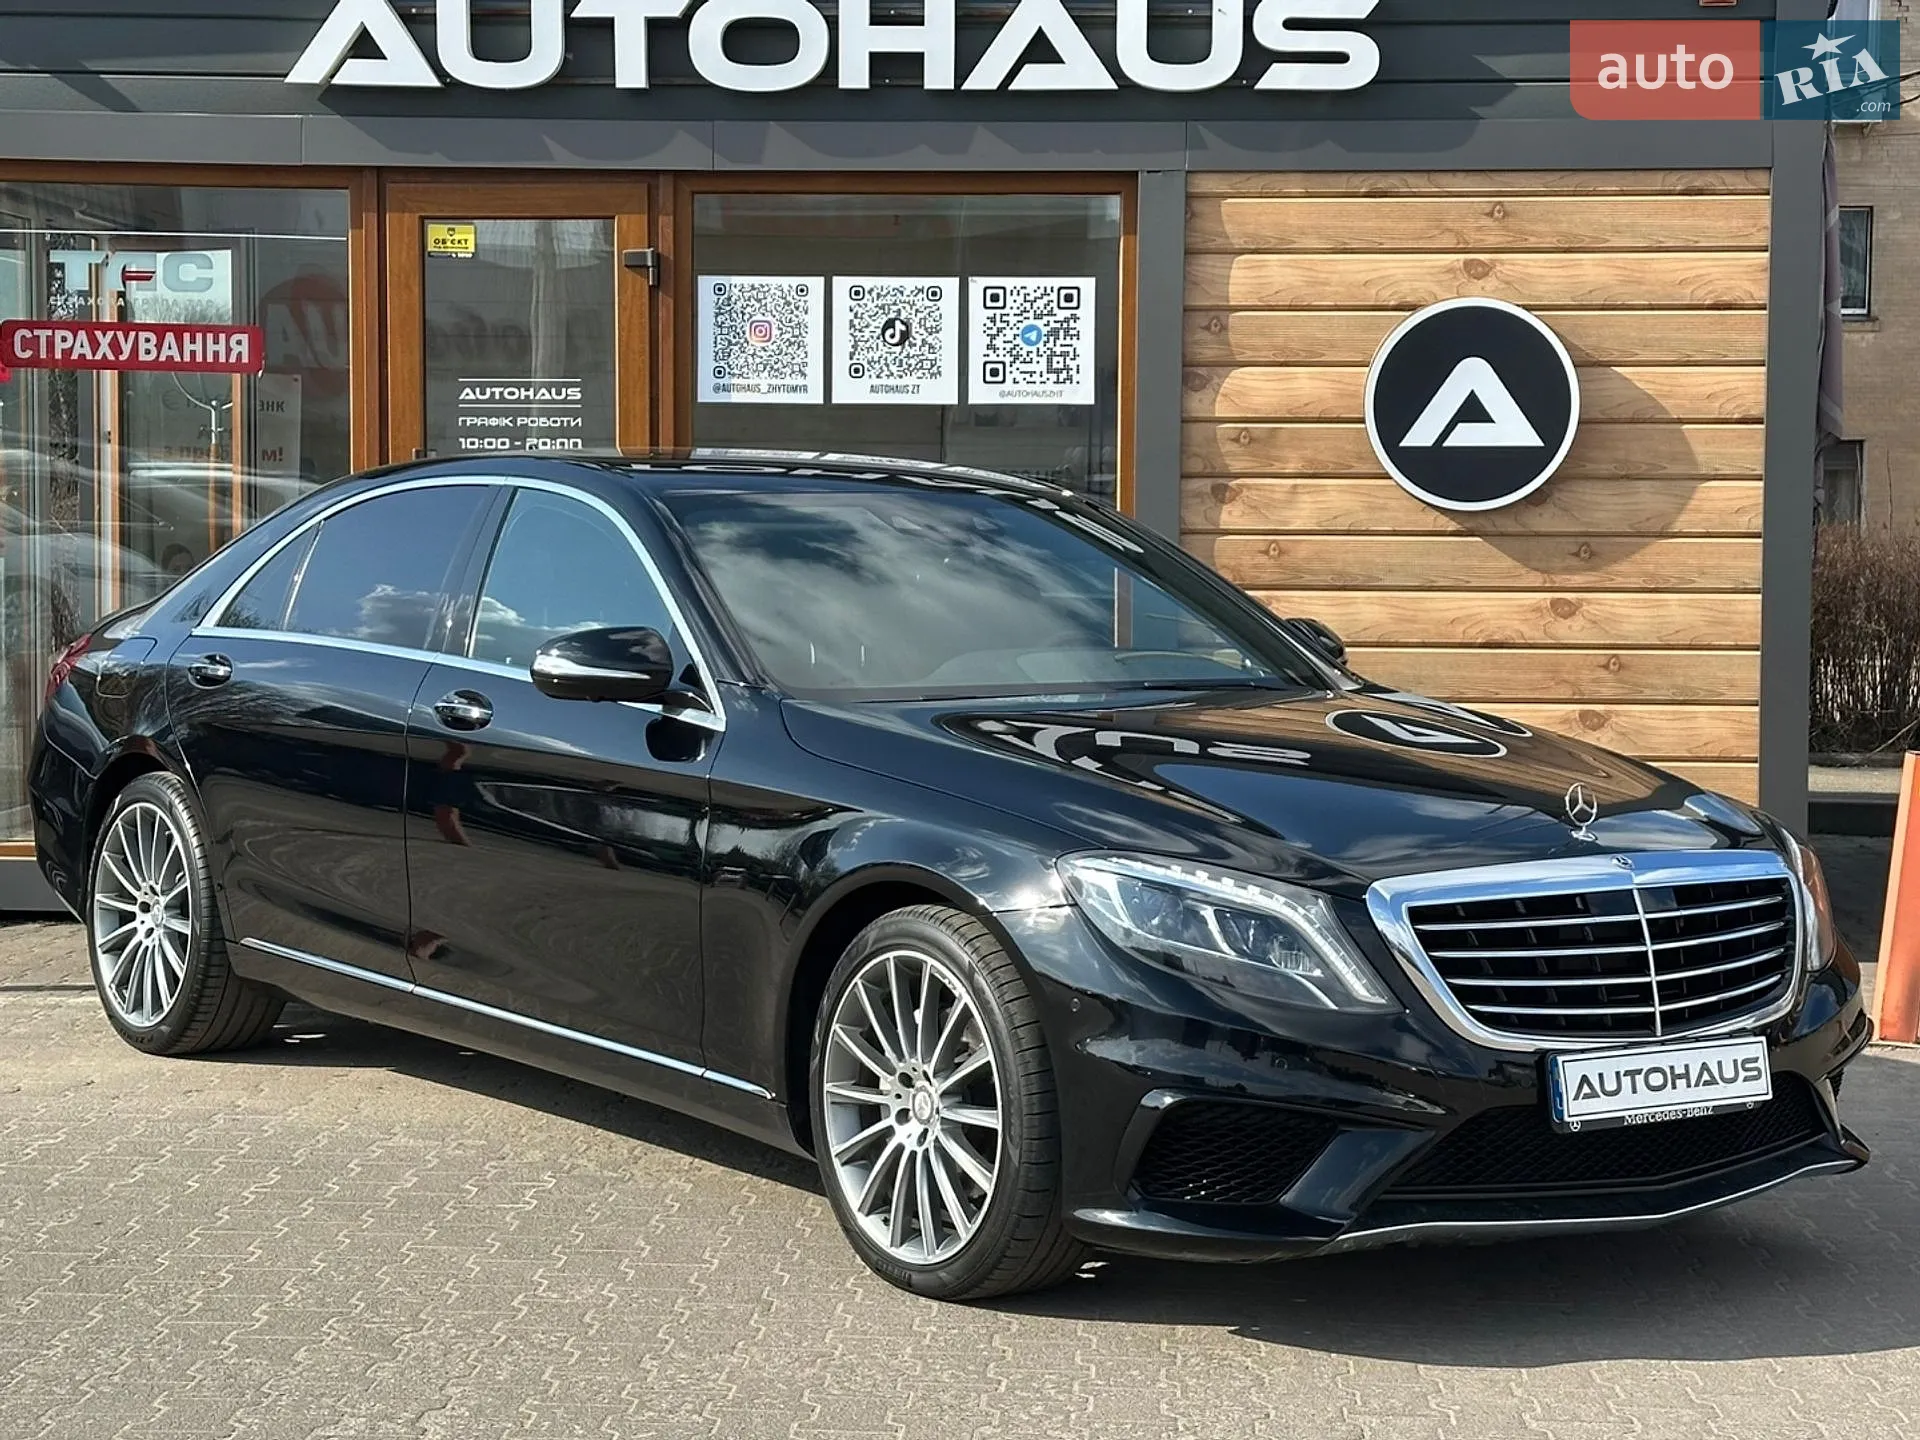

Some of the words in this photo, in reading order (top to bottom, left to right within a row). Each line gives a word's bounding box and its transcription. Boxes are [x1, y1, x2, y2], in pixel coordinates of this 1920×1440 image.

[285, 0, 1382, 93] AUTOHAUS
[13, 328, 250, 364] СТРАХУВАННЯ
[458, 387, 582, 400] AUTOHAUS
[869, 384, 911, 394] AUTOHAUS
[458, 417, 514, 427] ГРАФІК
[517, 417, 582, 427] РОБОТИ
[458, 438, 510, 449] 10:00
[1572, 1056, 1763, 1101] AUTOHAUS
[1623, 1106, 1714, 1126] Mercedes-Benz
